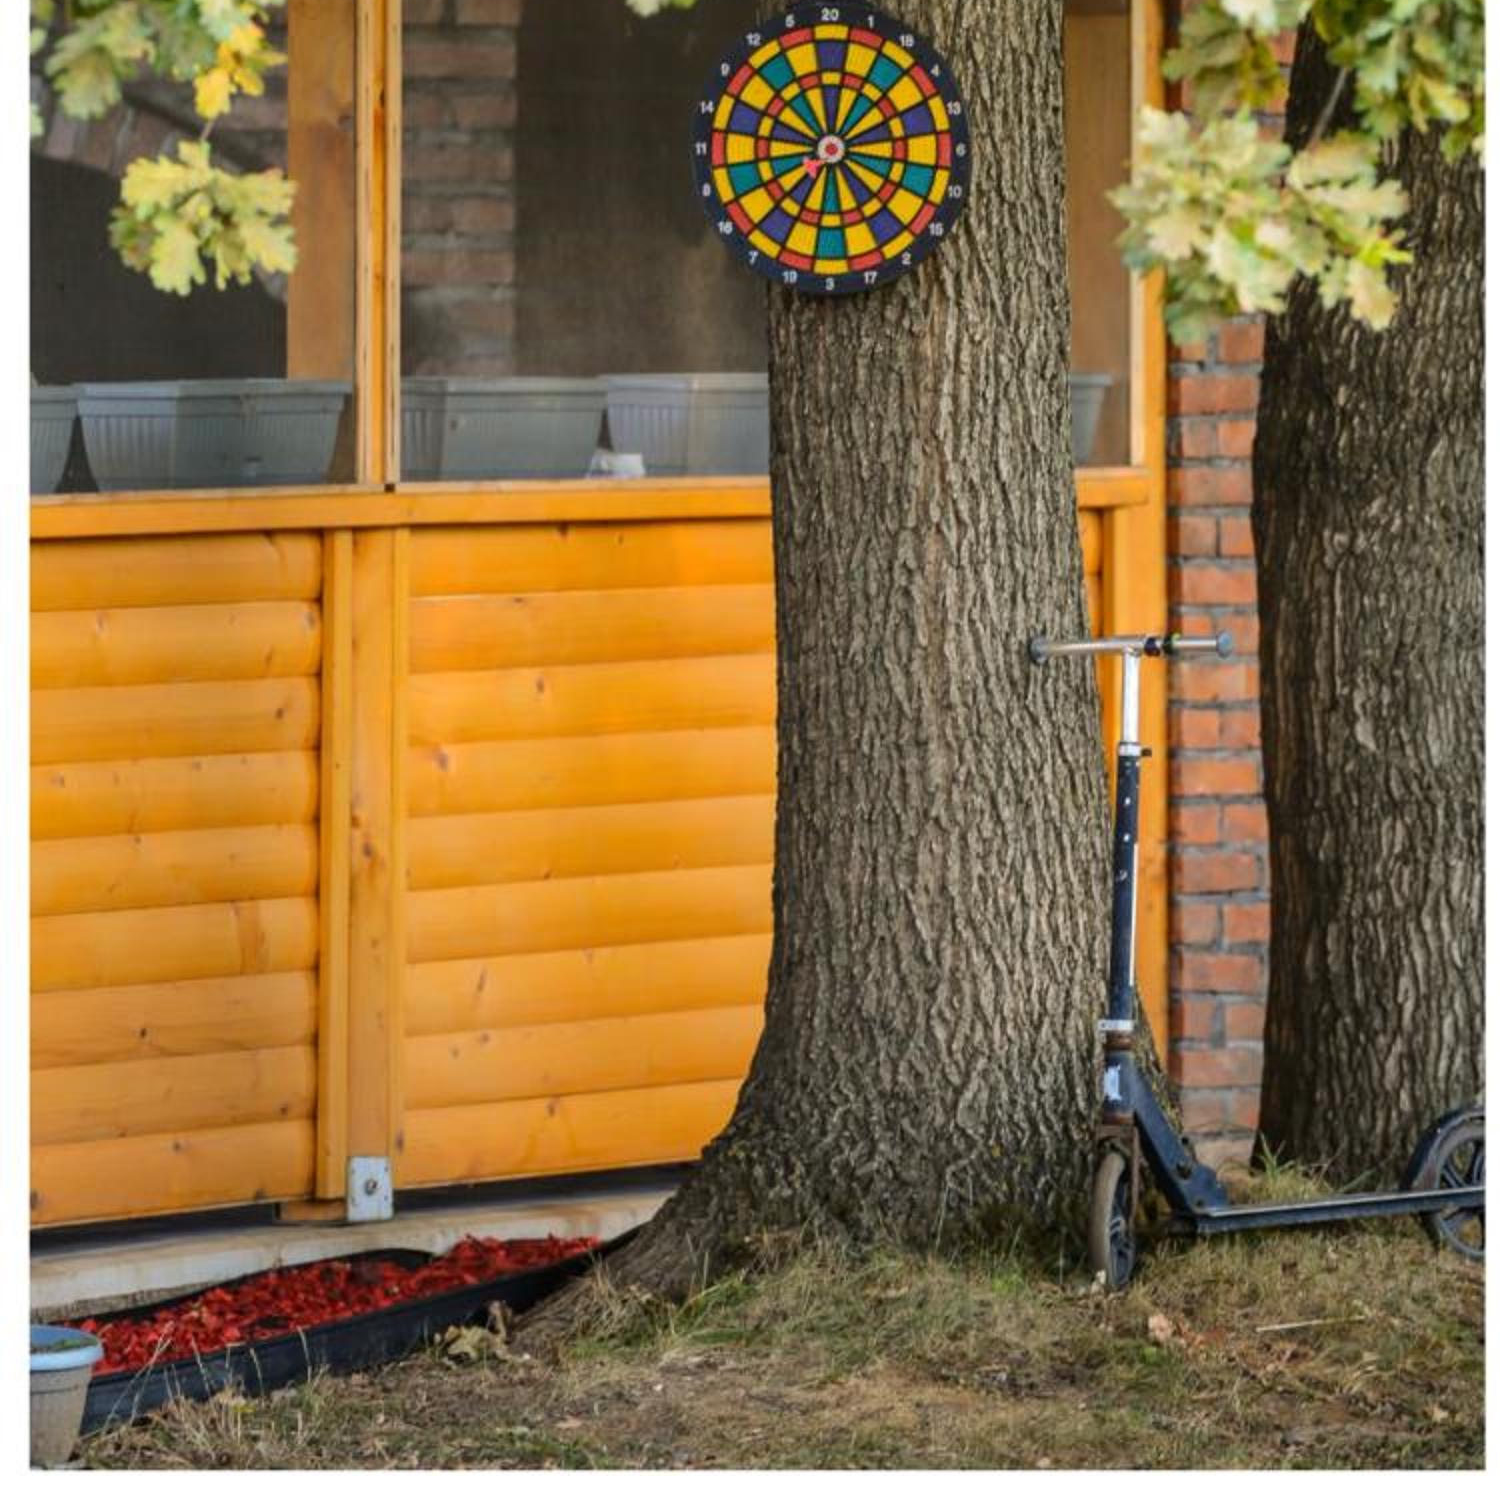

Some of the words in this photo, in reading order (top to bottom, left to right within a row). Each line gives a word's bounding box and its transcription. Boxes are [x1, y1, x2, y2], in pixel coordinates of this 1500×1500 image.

[822, 8, 839, 21] 20
[868, 15, 874, 28] 1
[746, 33, 760, 46] 12
[900, 34, 914, 47] 18
[721, 63, 730, 76] 9
[930, 63, 941, 77] 4
[700, 100, 714, 114] 14
[947, 101, 961, 115] 13
[696, 142, 706, 155] 11
[956, 143, 966, 156] 6
[948, 185, 962, 198] 10
[718, 221, 732, 235] 16
[929, 223, 944, 236] 15
[749, 251, 758, 264] 7
[902, 252, 911, 265] 2
[783, 270, 797, 283] 19
[864, 271, 877, 284] 17
